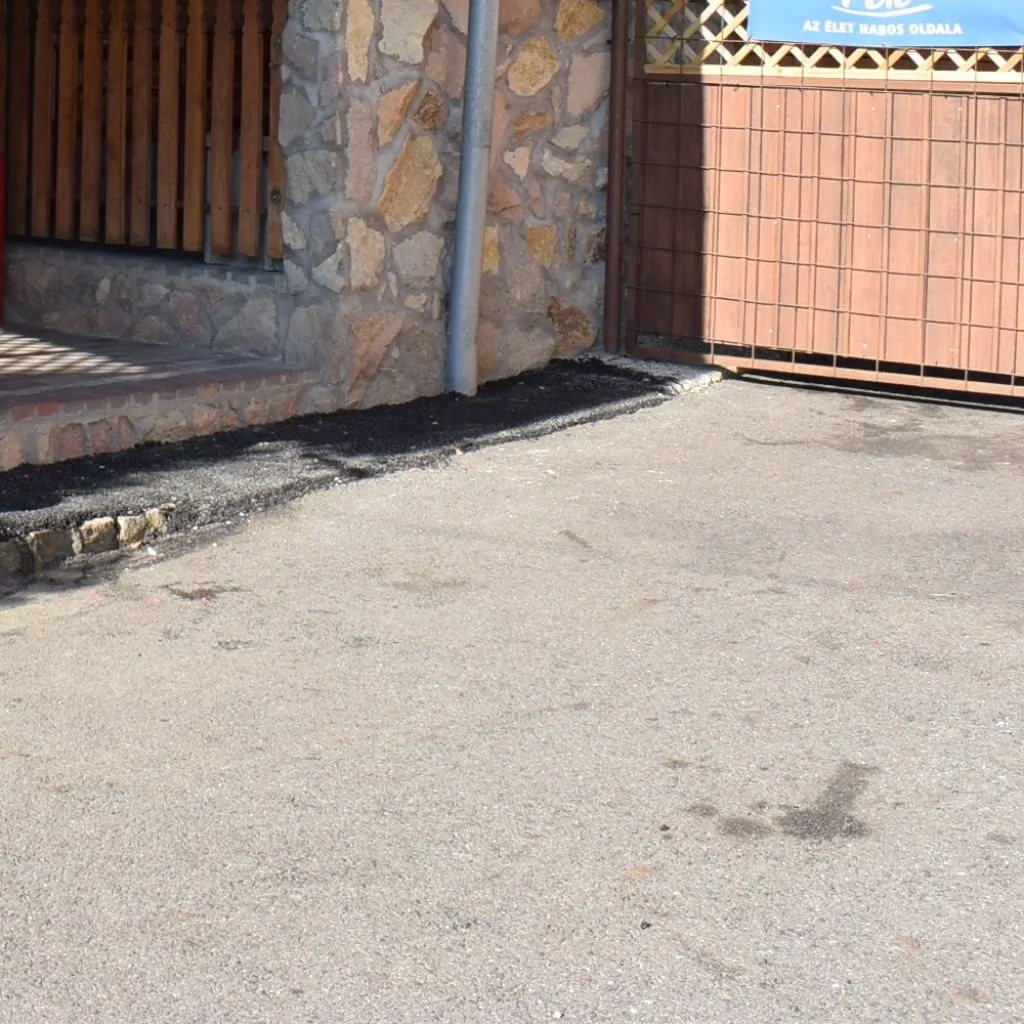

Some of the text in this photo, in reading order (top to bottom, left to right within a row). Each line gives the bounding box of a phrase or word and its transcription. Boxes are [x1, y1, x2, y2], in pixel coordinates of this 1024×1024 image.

[803, 19, 964, 36] AZ ÉLET HABOS OLDALA
